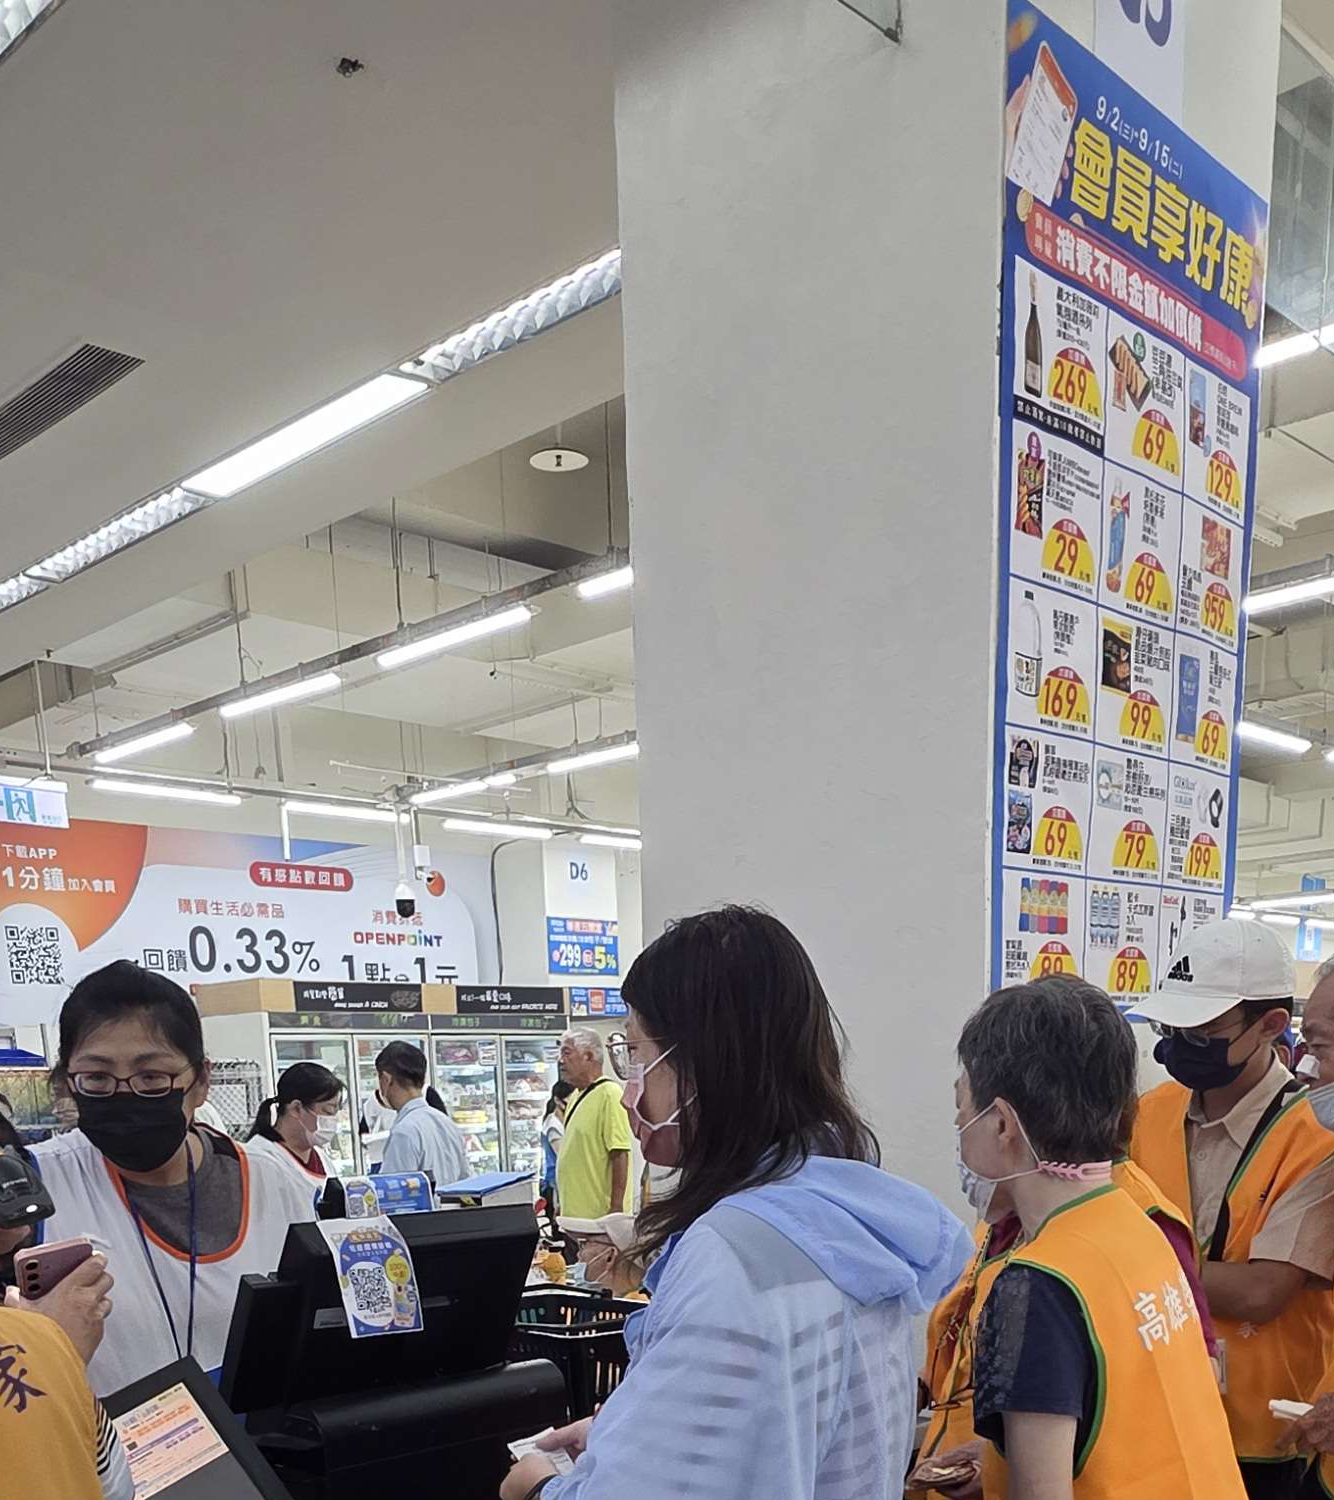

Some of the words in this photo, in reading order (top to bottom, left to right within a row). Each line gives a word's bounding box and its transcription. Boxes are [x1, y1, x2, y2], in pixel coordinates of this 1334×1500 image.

[1070, 117, 1255, 311] 會員享好康
[1053, 359, 1087, 407] 269
[1144, 423, 1165, 464] 69
[1209, 460, 1233, 503] 129
[1054, 535, 1078, 577] 29
[1134, 565, 1156, 604] 69
[1204, 592, 1226, 633] 959
[1044, 677, 1077, 720] 169
[1130, 703, 1151, 738] 99
[1201, 718, 1220, 756] 69
[2, 843, 57, 860] 下載APP
[1044, 820, 1067, 857] 69
[1124, 833, 1146, 868] 79
[259, 867, 346, 887] 有感點數回饋
[570, 861, 588, 881] D6
[1188, 844, 1210, 877] 199
[178, 898, 285, 920] 購買生活必需品
[1116, 960, 1139, 993] 89
